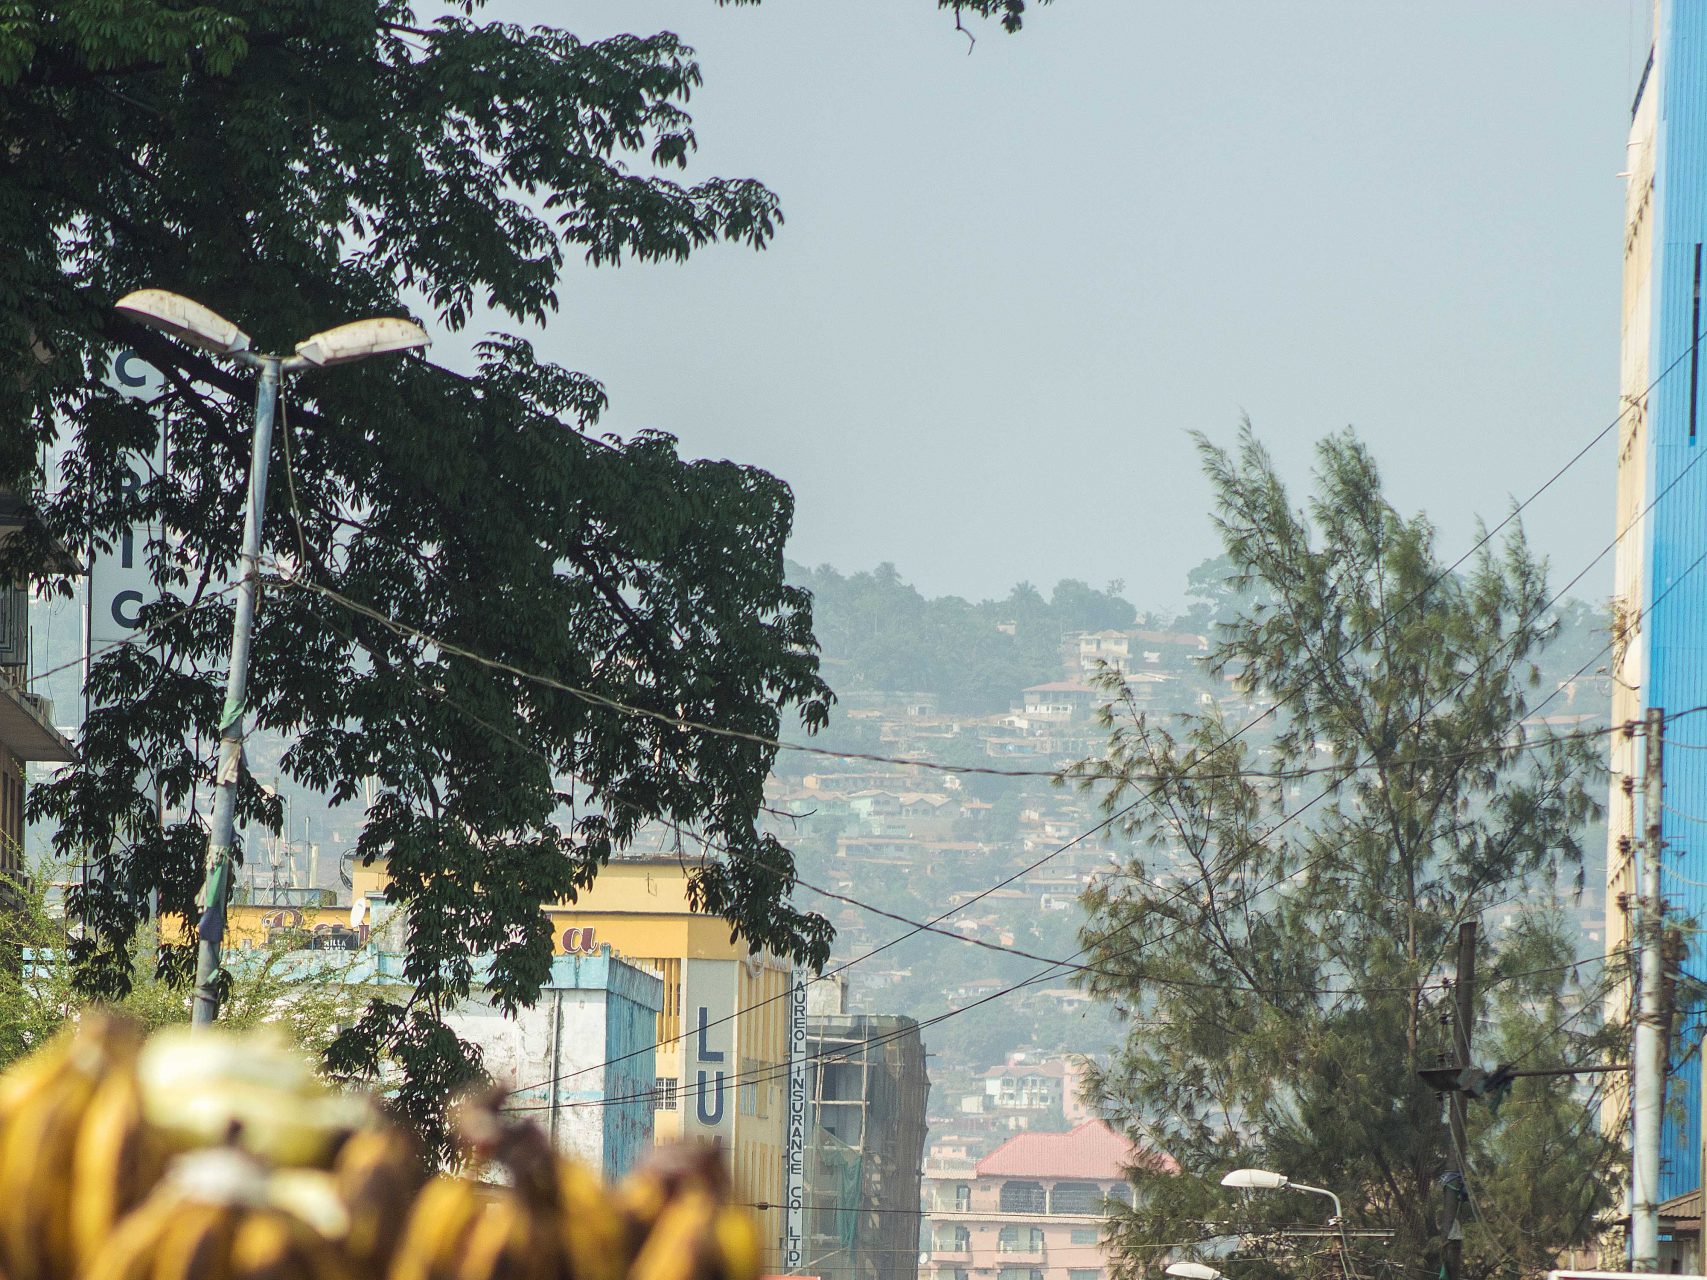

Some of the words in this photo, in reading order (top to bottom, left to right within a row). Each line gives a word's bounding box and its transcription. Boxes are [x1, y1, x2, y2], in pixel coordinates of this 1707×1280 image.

[793, 980, 806, 1054] AUREOL
[791, 1066, 805, 1175] INSURANCE
[787, 1226, 801, 1266] LTD.
